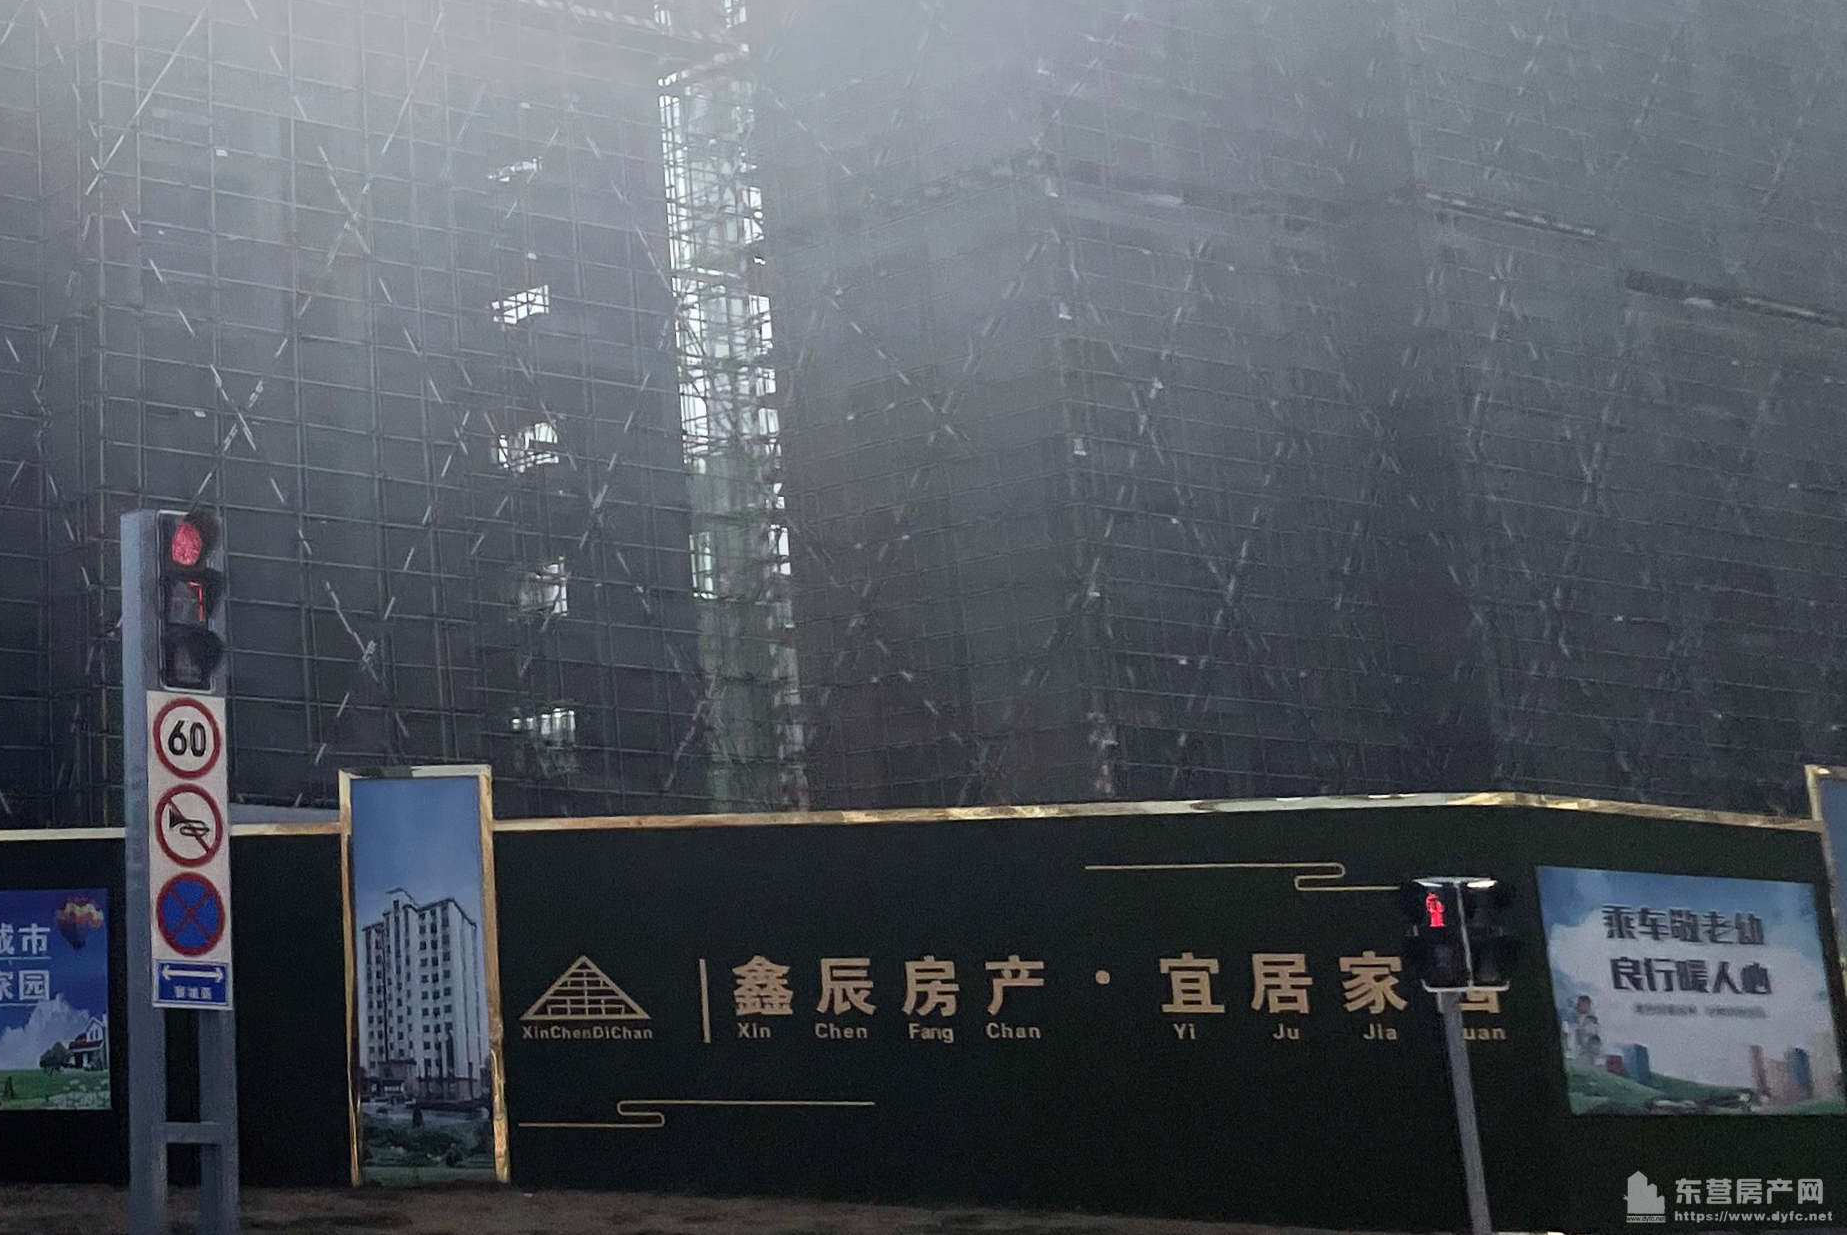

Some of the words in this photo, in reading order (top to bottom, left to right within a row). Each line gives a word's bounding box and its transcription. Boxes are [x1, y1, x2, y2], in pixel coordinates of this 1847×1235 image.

[167, 720, 207, 757] 60
[522, 1025, 653, 1040] XinChenDiChan
[737, 1022, 772, 1039] Xin
[814, 1022, 868, 1040] Chen
[908, 1022, 955, 1044] Fang
[986, 1022, 1042, 1040] Chan
[1173, 1022, 1196, 1041] Yi
[1272, 1023, 1300, 1041] Ju
[1362, 1023, 1398, 1041] Jia
[1462, 1027, 1507, 1041] uan
